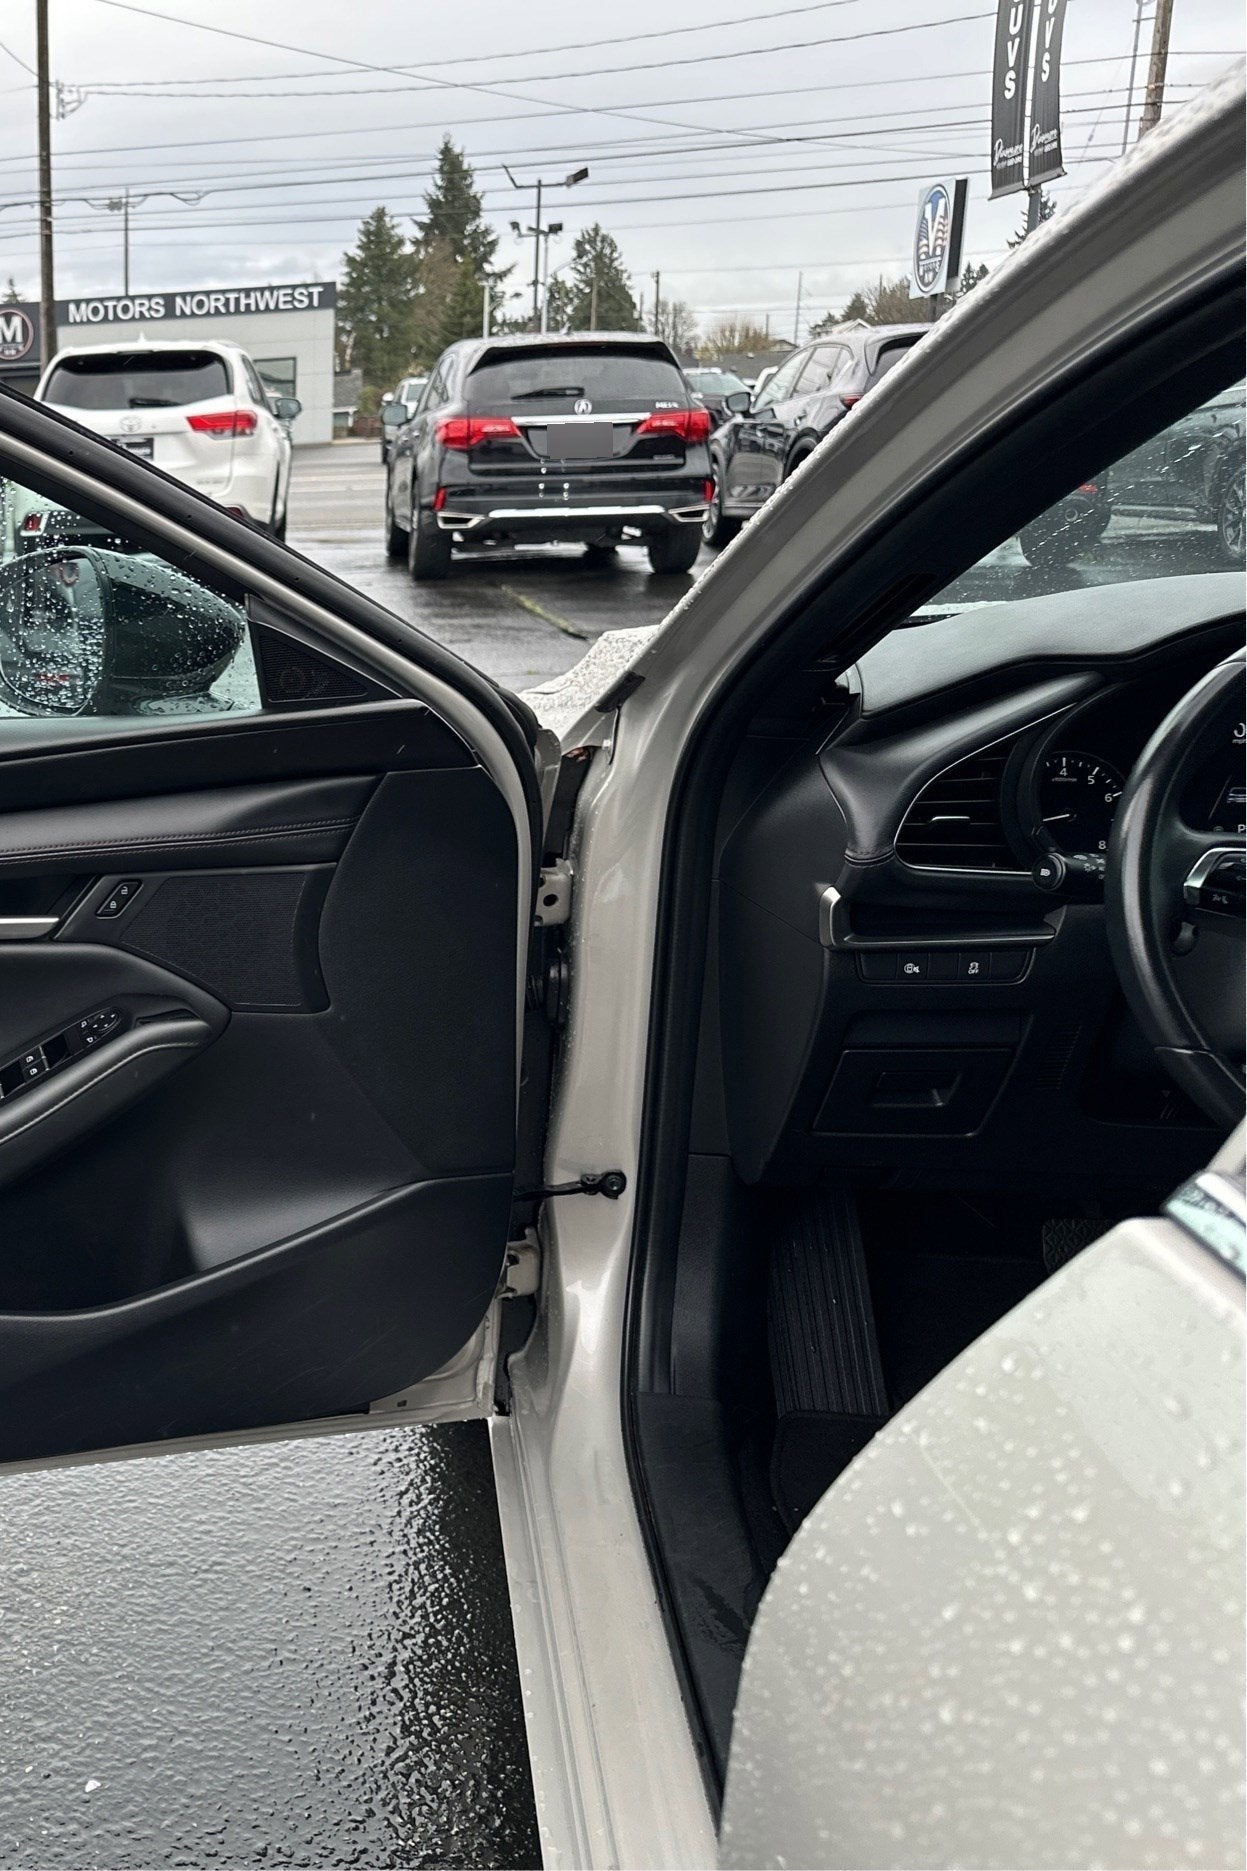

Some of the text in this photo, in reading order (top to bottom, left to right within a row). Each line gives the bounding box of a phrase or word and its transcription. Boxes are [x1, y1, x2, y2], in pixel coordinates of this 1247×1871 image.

[1004, 0, 1023, 99] UVS
[68, 286, 323, 323] MOTORS NORTHWEST
[1059, 768, 1068, 777] 4
[1087, 775, 1096, 785] 5
[1104, 793, 1113, 803] 6
[1098, 840, 1107, 850] 8
